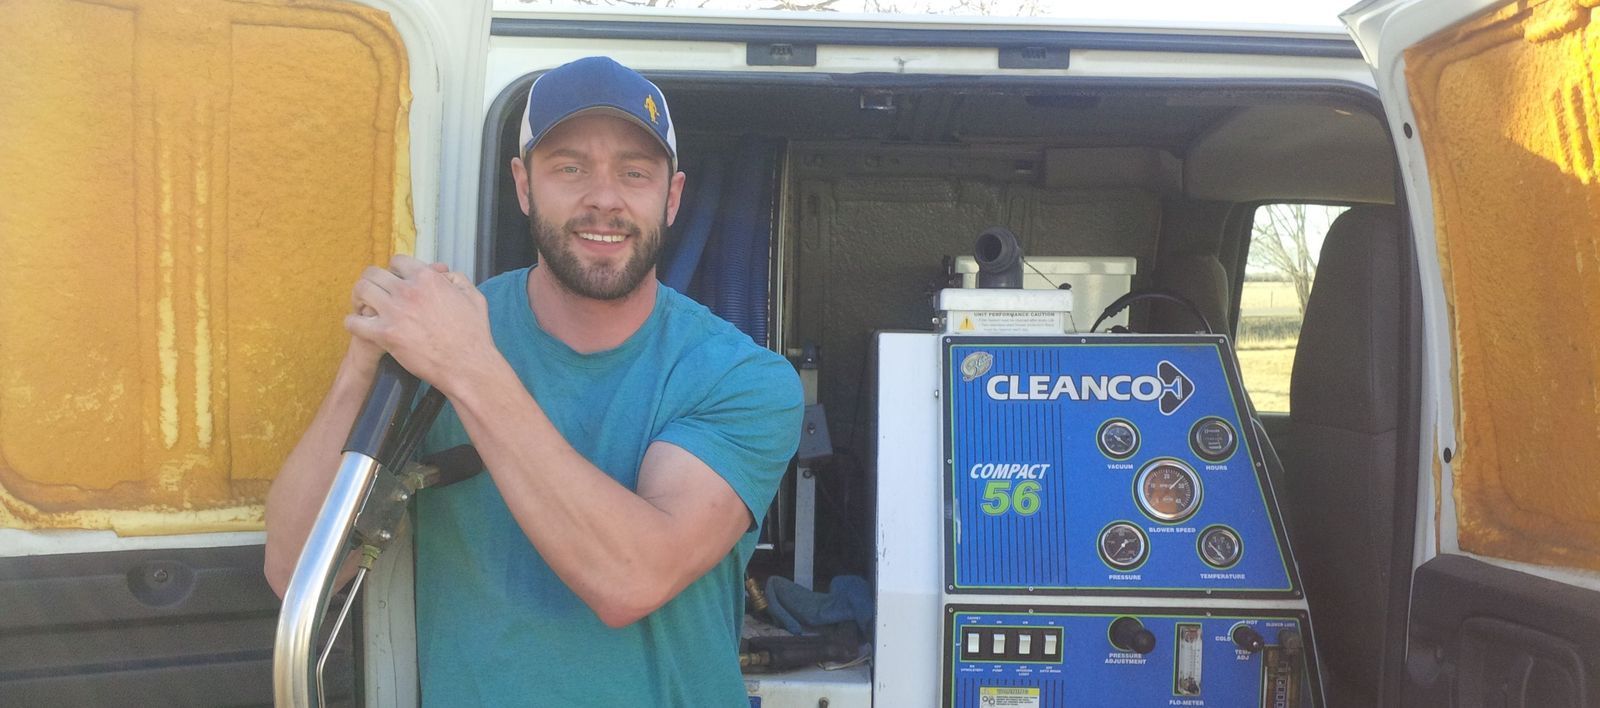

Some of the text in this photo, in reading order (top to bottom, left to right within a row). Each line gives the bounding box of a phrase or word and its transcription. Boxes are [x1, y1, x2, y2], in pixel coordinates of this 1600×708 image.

[986, 375, 1162, 401] CLEANCO
[970, 463, 1050, 480] COMPACT
[980, 480, 1042, 516] 56
